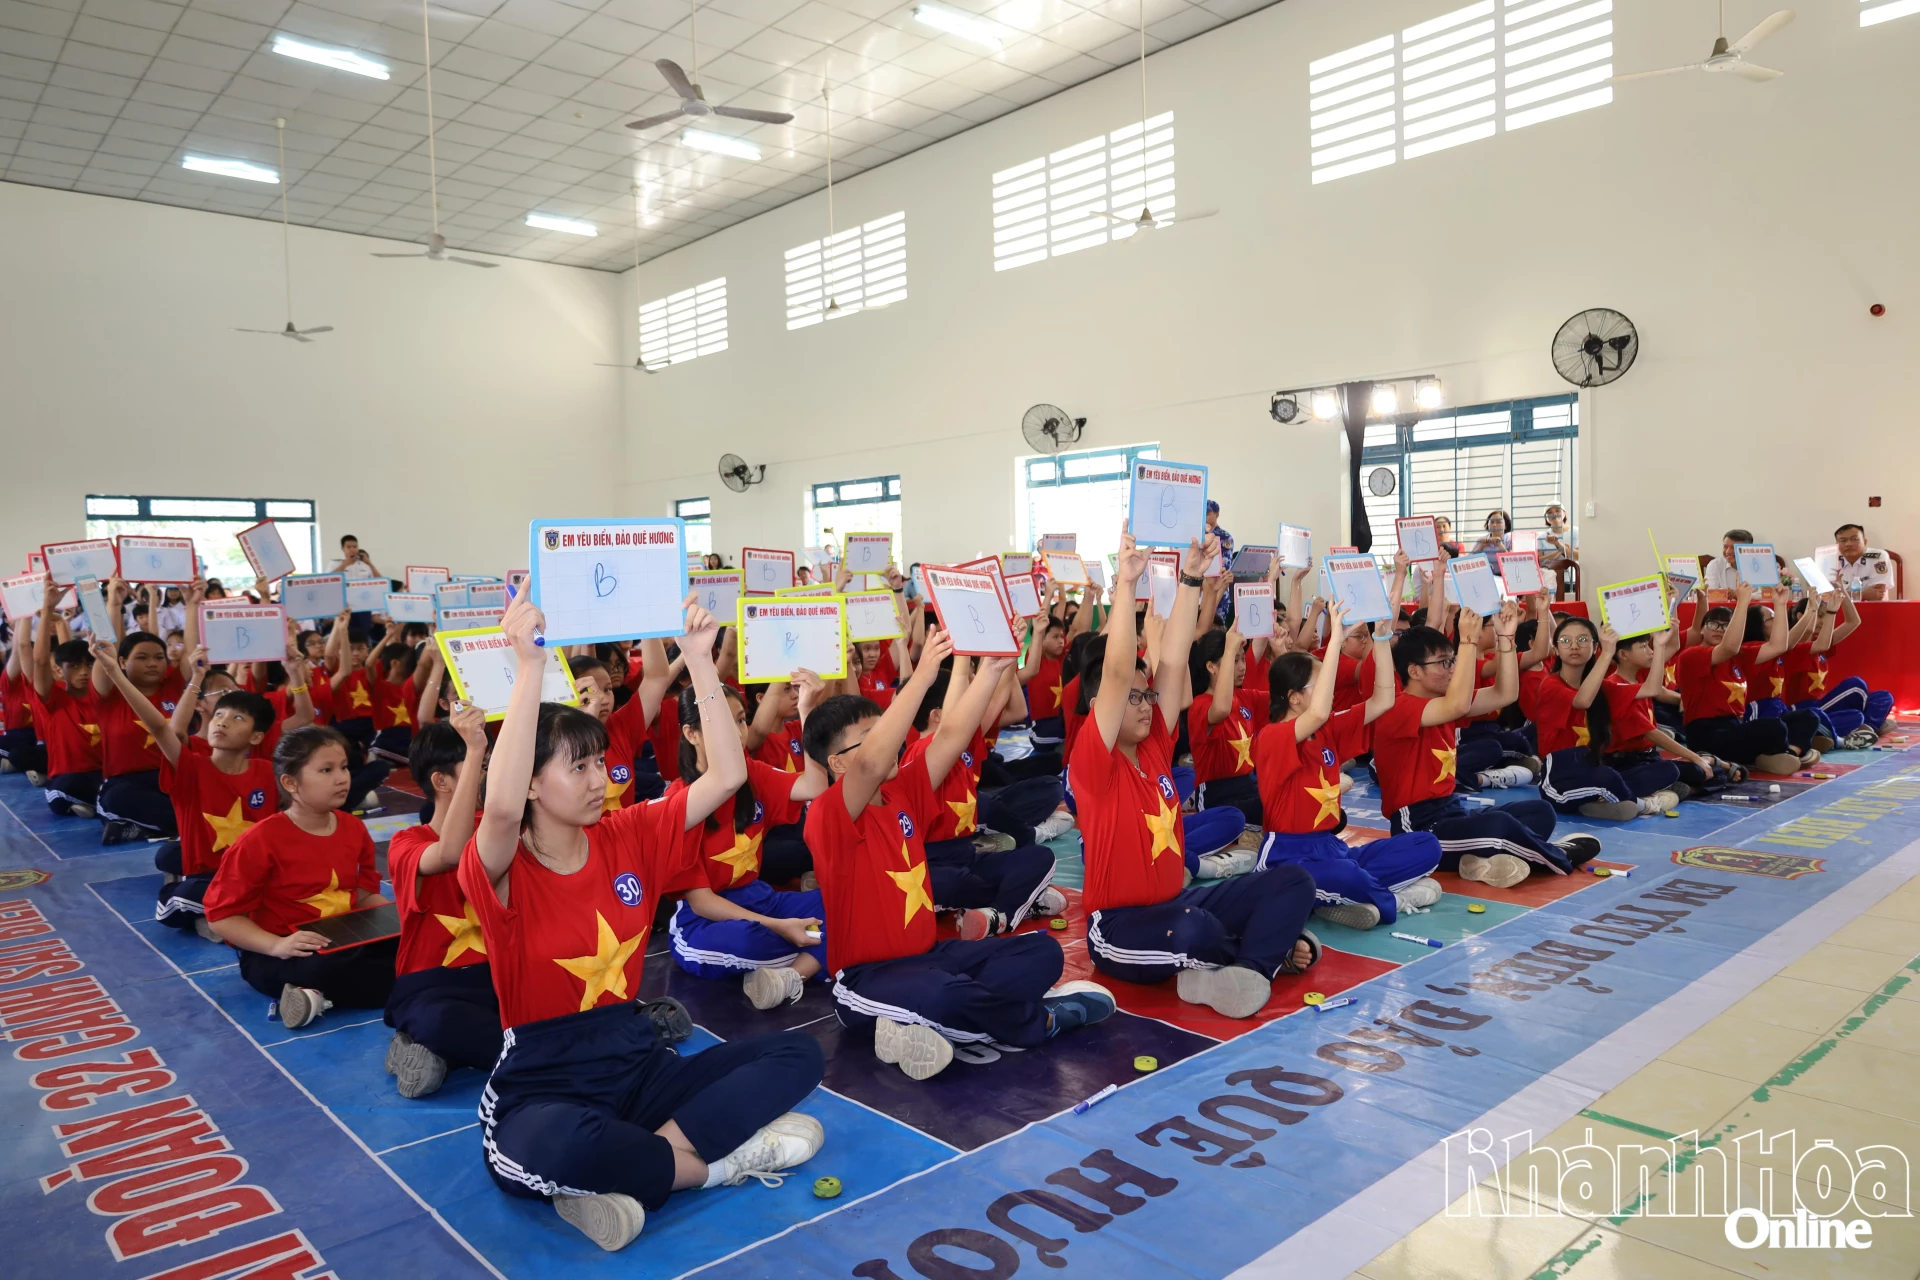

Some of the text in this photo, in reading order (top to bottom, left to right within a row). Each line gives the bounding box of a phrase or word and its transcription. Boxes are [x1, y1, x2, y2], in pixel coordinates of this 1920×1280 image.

[1160, 484, 1178, 528] B
[562, 528, 674, 548] EM YÊU BIỂN, ĐẢO QUÊ HƯƠNG
[1415, 529, 1431, 556] B
[863, 546, 872, 562] B
[594, 562, 617, 598] B
[759, 608, 768, 617] EM
[769, 606, 780, 617] YÊU
[808, 605, 819, 616] QUÊ
[820, 606, 838, 615] HƯƠNG
[1250, 603, 1261, 626] B
[236, 626, 250, 649] B
[464, 641, 475, 652] EM
[474, 638, 488, 651] YÊU
[503, 667, 514, 685] B
[612, 767, 628, 780] 39
[250, 790, 265, 806] 45
[1159, 776, 1175, 799] 28
[899, 815, 913, 835] 29
[1757, 816, 1872, 850] BIỂN
[616, 877, 640, 901] 30
[1639, 878, 1738, 907] EM
[1569, 903, 1693, 946] YÊU
[1316, 1000, 1493, 1074] ĐẢO
[29, 1046, 178, 1112] 32
[1135, 1065, 1344, 1169] QUÊ
[40, 1095, 283, 1262] ĐOÀN
